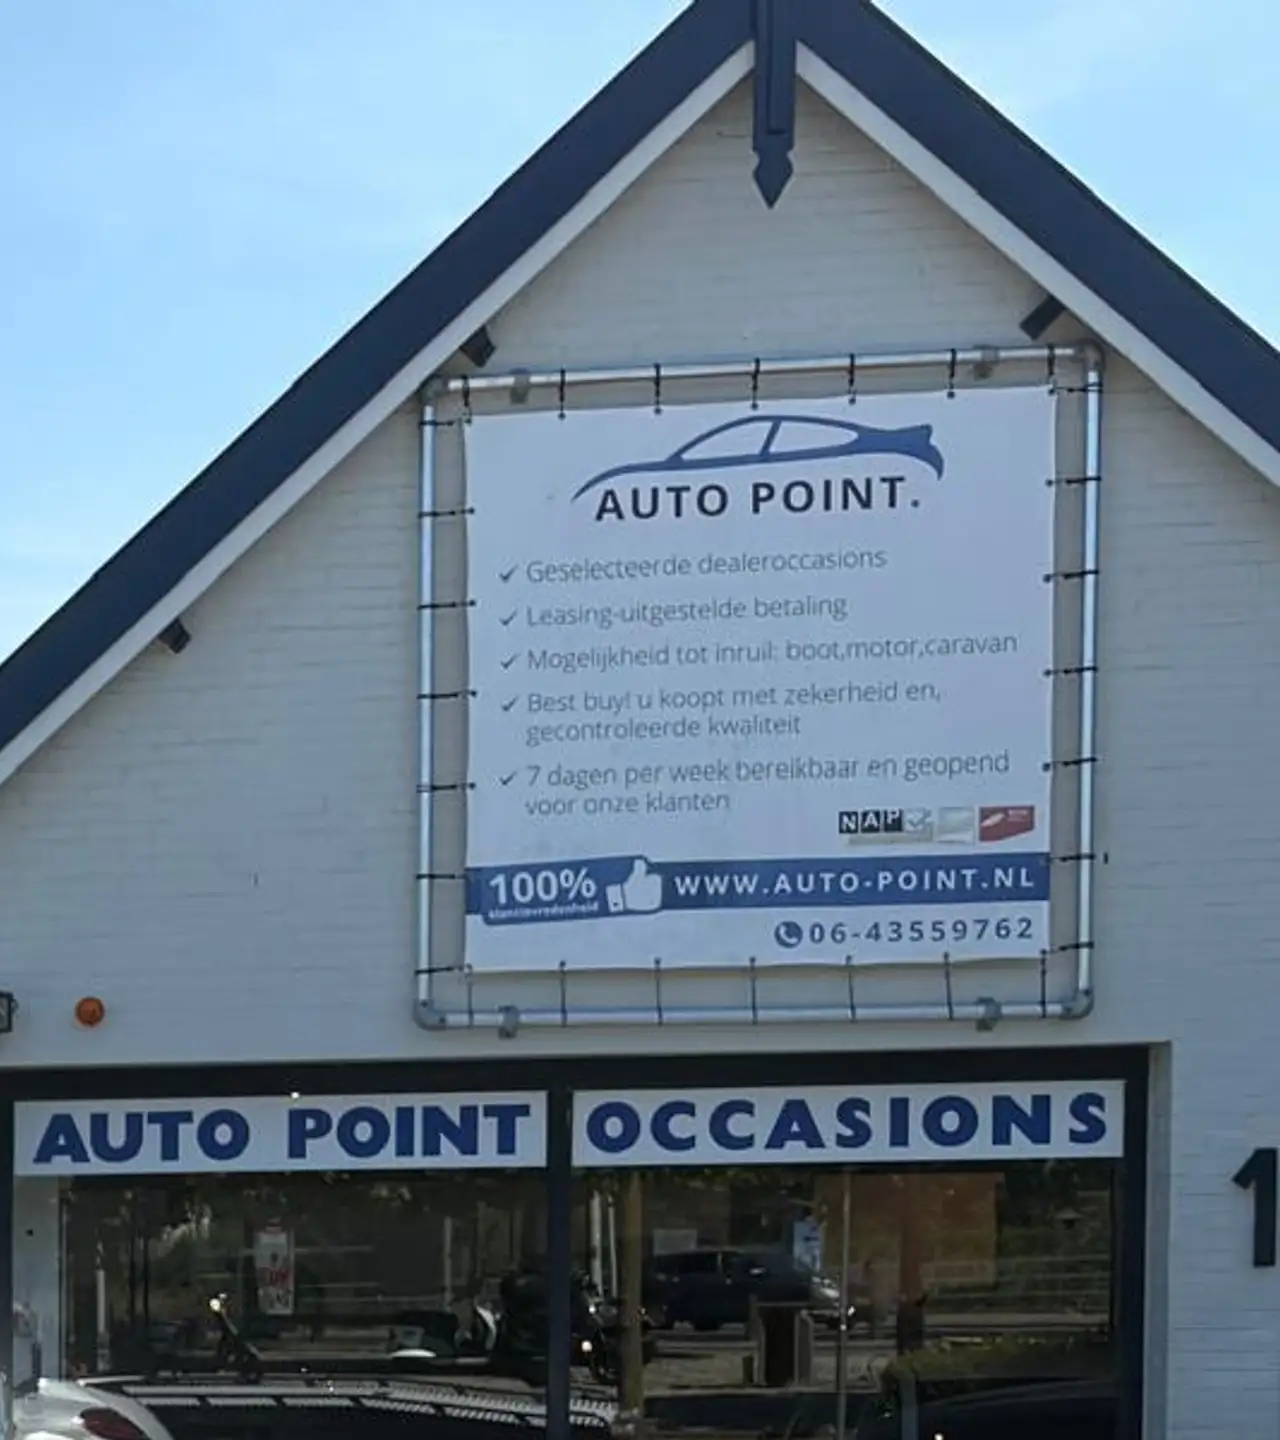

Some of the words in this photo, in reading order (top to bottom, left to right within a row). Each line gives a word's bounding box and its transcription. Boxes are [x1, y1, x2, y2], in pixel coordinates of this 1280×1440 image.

[595, 483, 729, 522] AUTO
[526, 556, 691, 584] Geselecteerde
[697, 549, 889, 575] dealeroccasions
[526, 599, 747, 629] Leasing-uitgestelde
[753, 595, 848, 622] betaling
[526, 646, 670, 673] Mogelijkheid
[676, 645, 707, 666] tot
[526, 693, 576, 713] Best
[637, 693, 652, 709] u
[659, 689, 725, 713] koopt
[731, 687, 777, 707] met
[783, 681, 899, 706] zekerheid
[525, 716, 701, 748] gecontroleerde
[707, 713, 802, 738] kwaliteit
[527, 765, 542, 786] 7
[547, 763, 617, 790] dagen
[624, 765, 665, 789] per
[669, 759, 730, 782] week
[734, 755, 860, 782] bereikbaar
[866, 757, 898, 775] en
[903, 750, 1011, 782] geopend
[525, 798, 575, 817] voor
[582, 797, 639, 815] onze
[645, 790, 731, 812] klanten
[840, 809, 903, 832] NAP
[489, 867, 598, 905] 100%
[674, 867, 1035, 897] WWW.AUTO-POINT.NL
[809, 917, 1033, 944] 06-43559762
[33, 1108, 250, 1164] AUTO
[287, 1104, 530, 1159] POINT
[586, 1091, 1108, 1154] OCCASIONS
[1231, 1147, 1278, 1268] 1
